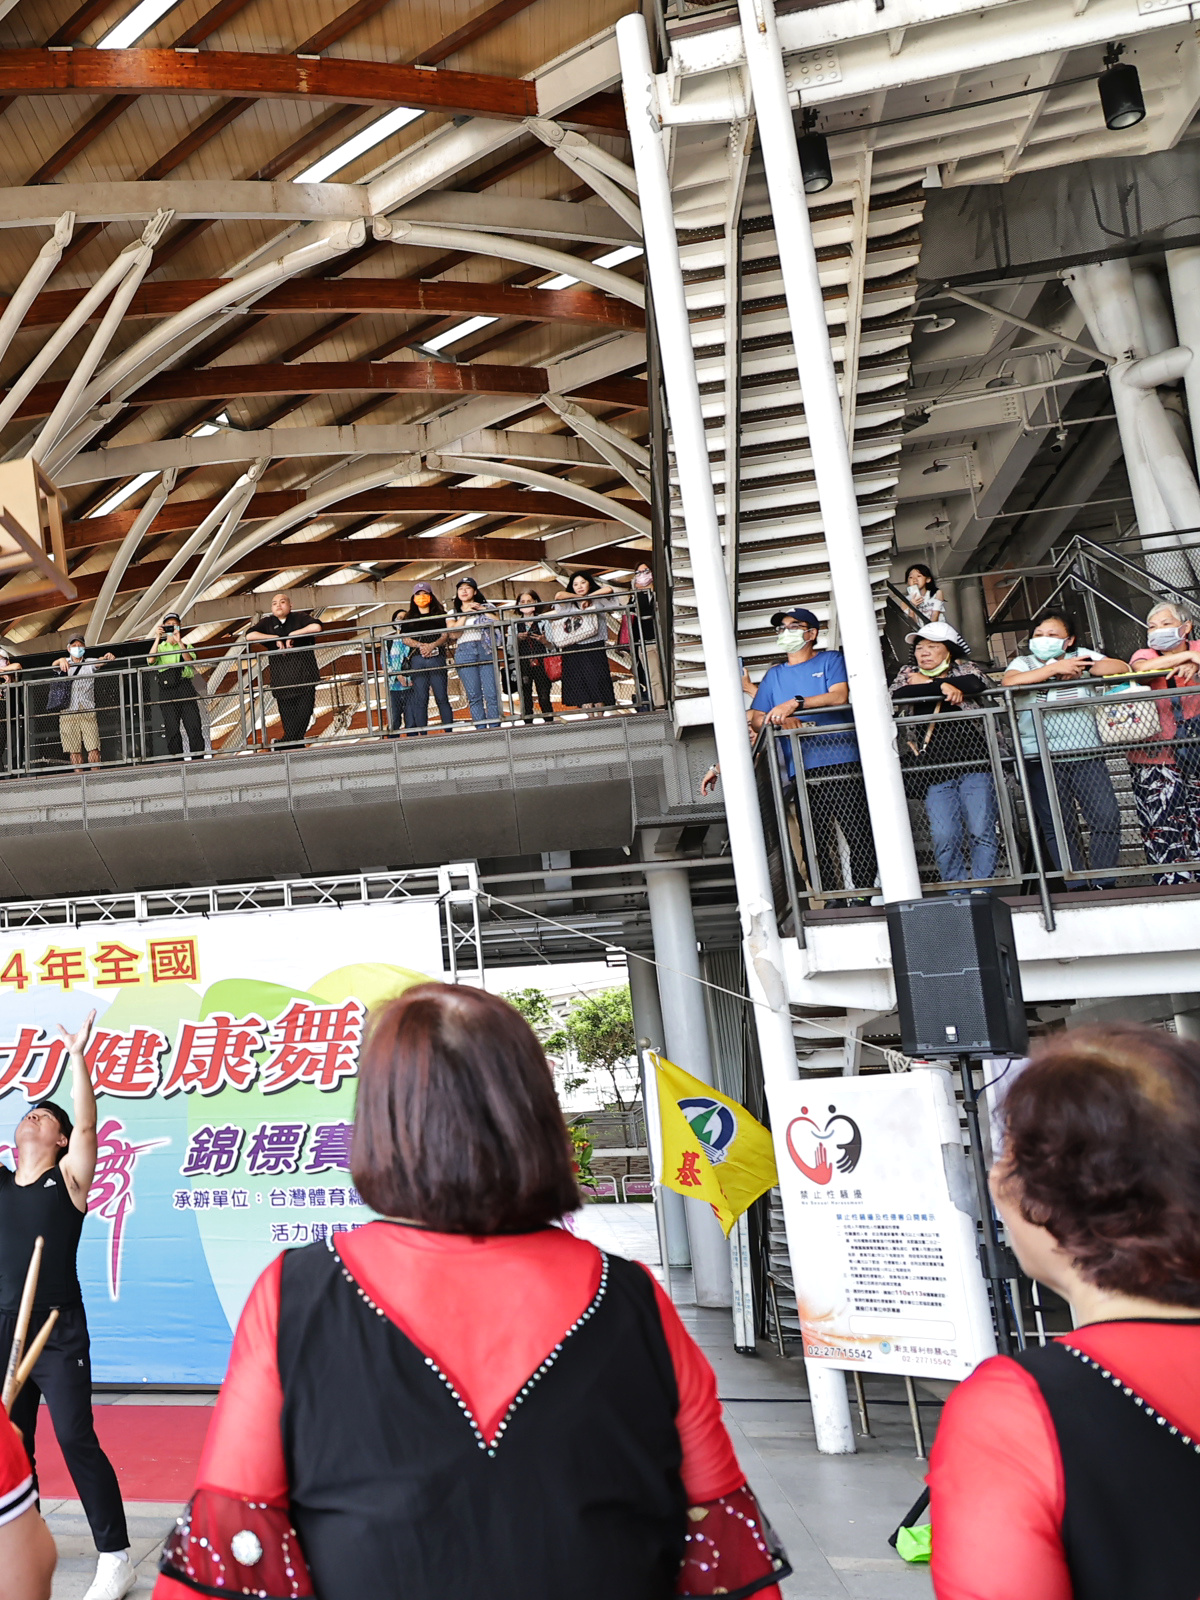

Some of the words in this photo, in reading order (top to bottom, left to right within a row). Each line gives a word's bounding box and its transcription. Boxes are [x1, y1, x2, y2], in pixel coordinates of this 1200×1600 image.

[182, 1121, 355, 1173] 錦標賽
[808, 1345, 873, 1360] 02-27715542
